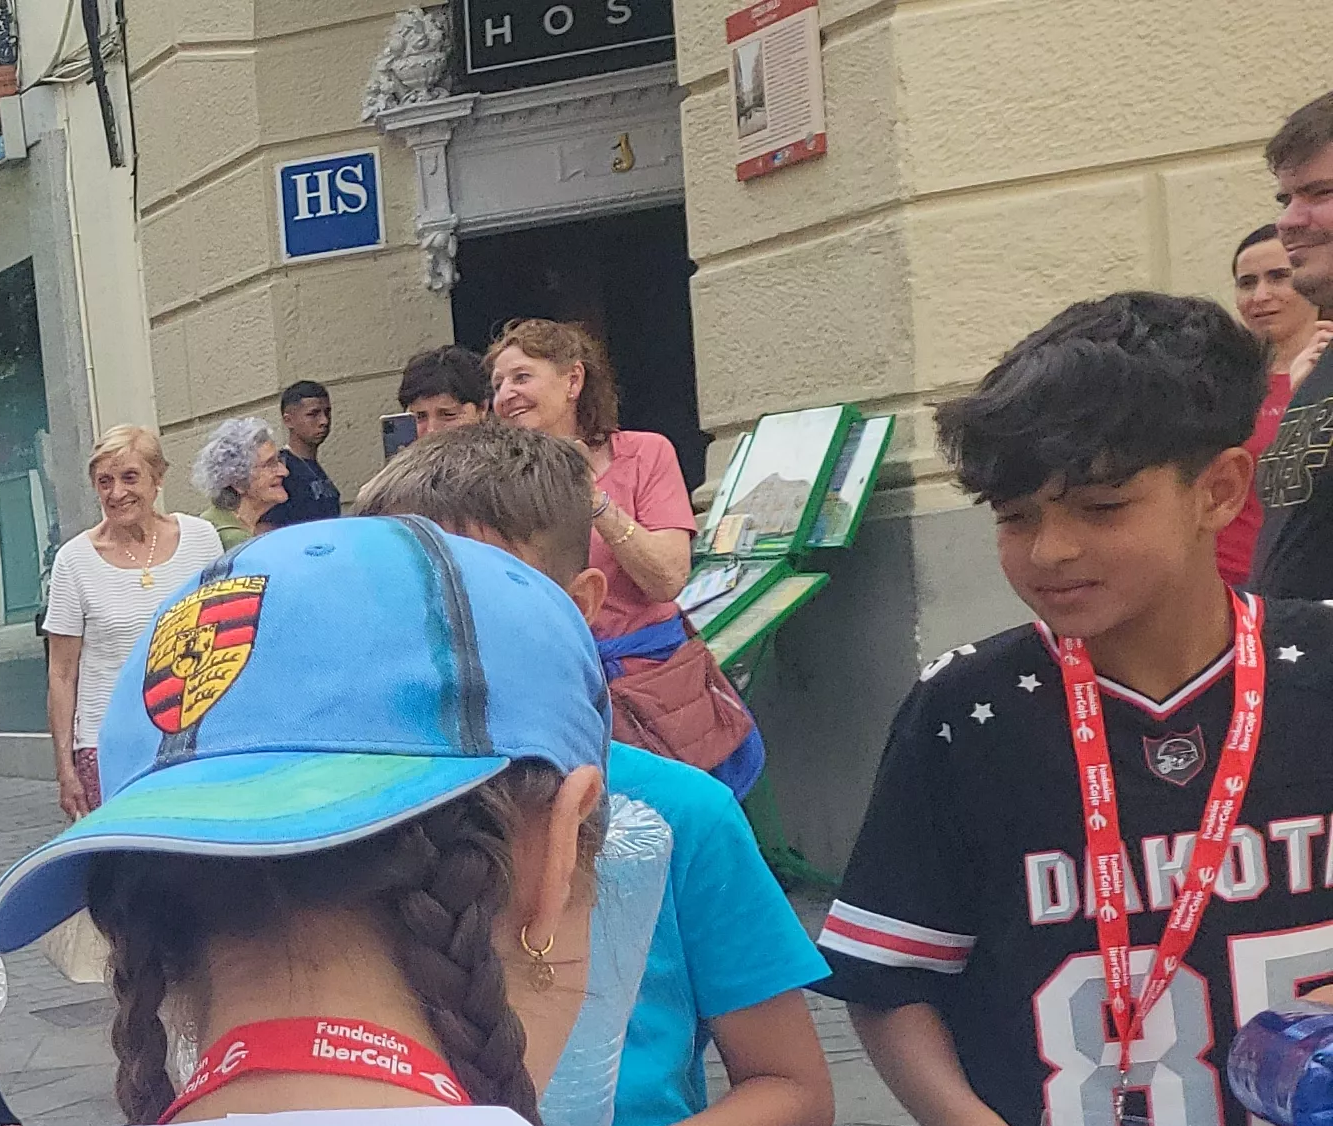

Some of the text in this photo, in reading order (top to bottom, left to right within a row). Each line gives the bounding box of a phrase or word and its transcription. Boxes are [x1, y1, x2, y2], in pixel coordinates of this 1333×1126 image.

[291, 163, 368, 220] HS
[1024, 813, 1333, 926] DAKOT
[311, 1038, 413, 1075] iberCaja
[316, 1021, 409, 1055] Fundación
